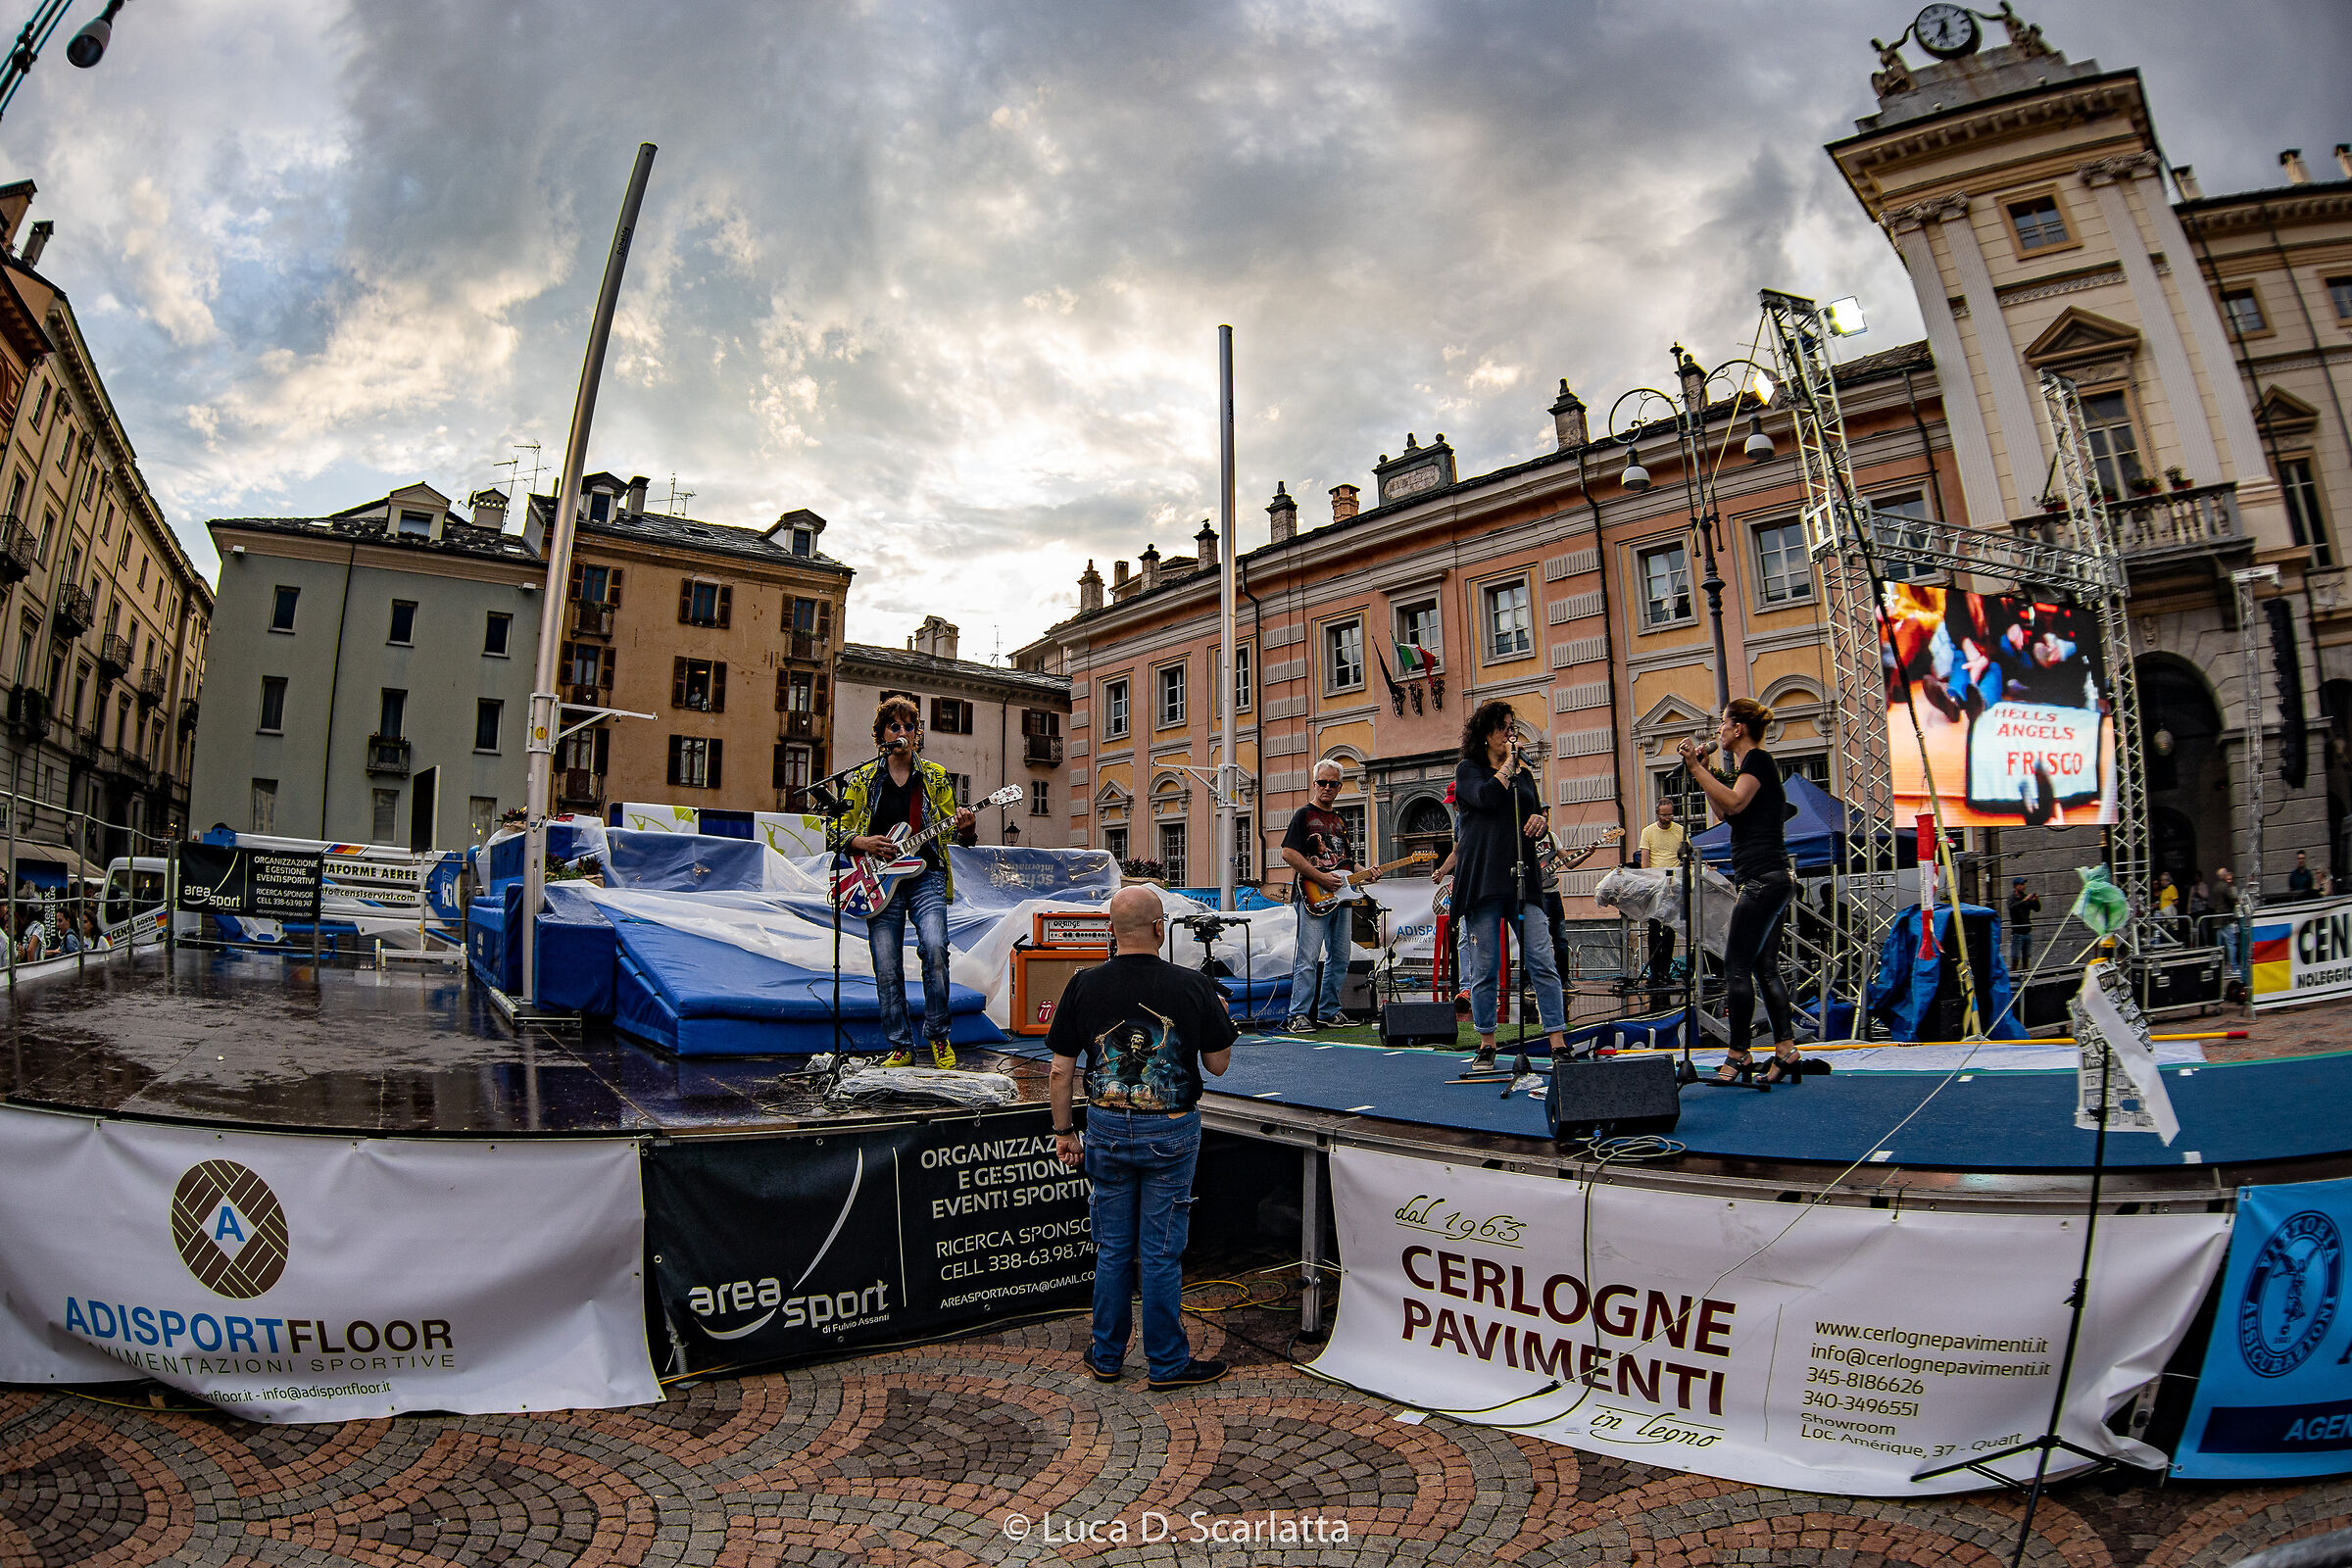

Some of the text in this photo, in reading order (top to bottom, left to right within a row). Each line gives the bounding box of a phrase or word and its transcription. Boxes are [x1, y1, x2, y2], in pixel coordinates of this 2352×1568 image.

[1993, 708, 2058, 722] HELLS
[1996, 723, 2076, 740] ANGELS
[254, 856, 318, 868] ORGANIZZAZIONE
[271, 866, 307, 876] GESTIONE
[322, 863, 417, 881] TAFORME AEREE
[184, 885, 211, 898] area
[256, 873, 316, 885] EVENTI SPORTIVI
[208, 895, 241, 908] sport
[256, 888, 314, 899] RICERCA SPONSOR
[320, 885, 416, 903] nfo@censiservizi.com
[136, 915, 155, 927] AOSTA
[1054, 920, 1081, 929] ORANGE
[2298, 912, 2352, 965] CEN
[920, 1131, 1085, 1169] ORGANIZZAZ
[958, 1170, 970, 1190] E
[932, 1177, 1096, 1219] EVENTI SPORTIV
[214, 1205, 246, 1243] A
[1395, 1195, 1527, 1240] dal 1963
[936, 1217, 1092, 1258] RICERCA SPONSO
[941, 1258, 984, 1281] CELL
[688, 1277, 781, 1316] area
[940, 1270, 1096, 1309] AREASPORTAOSTA@GMAIL.CO
[1400, 1245, 1737, 1358] CERLOGNE
[782, 1279, 889, 1329] sport
[66, 1296, 454, 1353] ADISPORTFLOOR
[822, 1312, 890, 1334] di Fulvio Assanti
[1815, 1321, 2049, 1353] www.cerlognepavimenti.it
[98, 1344, 455, 1375] VIMENTAZIONI SPORTIVE
[1401, 1297, 1726, 1416] PAVIMENTI
[1810, 1343, 2051, 1376] info@cerlognepavimenti.it
[262, 1381, 391, 1400] info@adisportfloor.it
[1806, 1366, 1924, 1395] 345-8186626
[1802, 1390, 1919, 1417] 340-3496551
[1590, 1410, 1722, 1447] in legno
[1800, 1412, 1895, 1436] Showroom
[2282, 1414, 2352, 1442] AGEN
[1800, 1423, 1837, 1441] Loc.
[1840, 1433, 1927, 1458] Amérique,
[1932, 1445, 1956, 1456] 37
[1971, 1433, 2022, 1450] Quart
